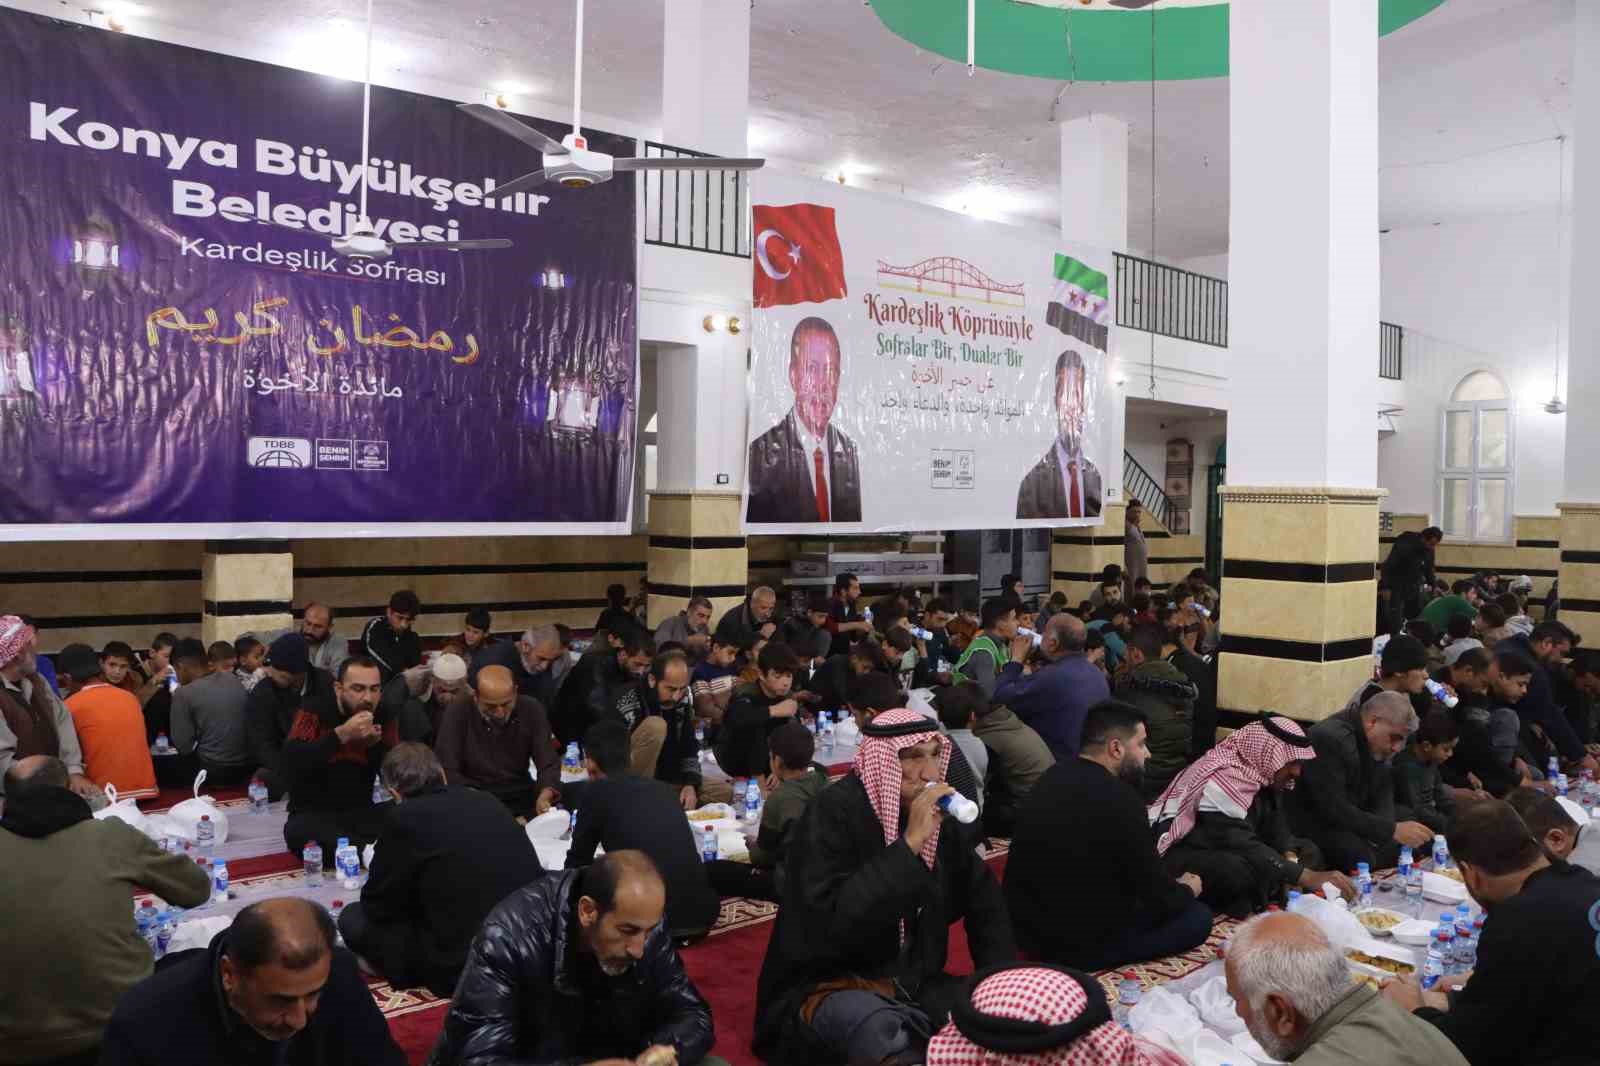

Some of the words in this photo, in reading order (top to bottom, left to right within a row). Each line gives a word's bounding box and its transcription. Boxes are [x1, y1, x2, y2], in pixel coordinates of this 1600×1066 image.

[30, 101, 238, 170] Konya
[181, 236, 337, 272] Kardeşlik
[146, 297, 289, 346] كريم
[306, 304, 480, 364] رمضان
[863, 293, 948, 335] Kardeşlik
[948, 306, 1034, 345] Köprüsüyle
